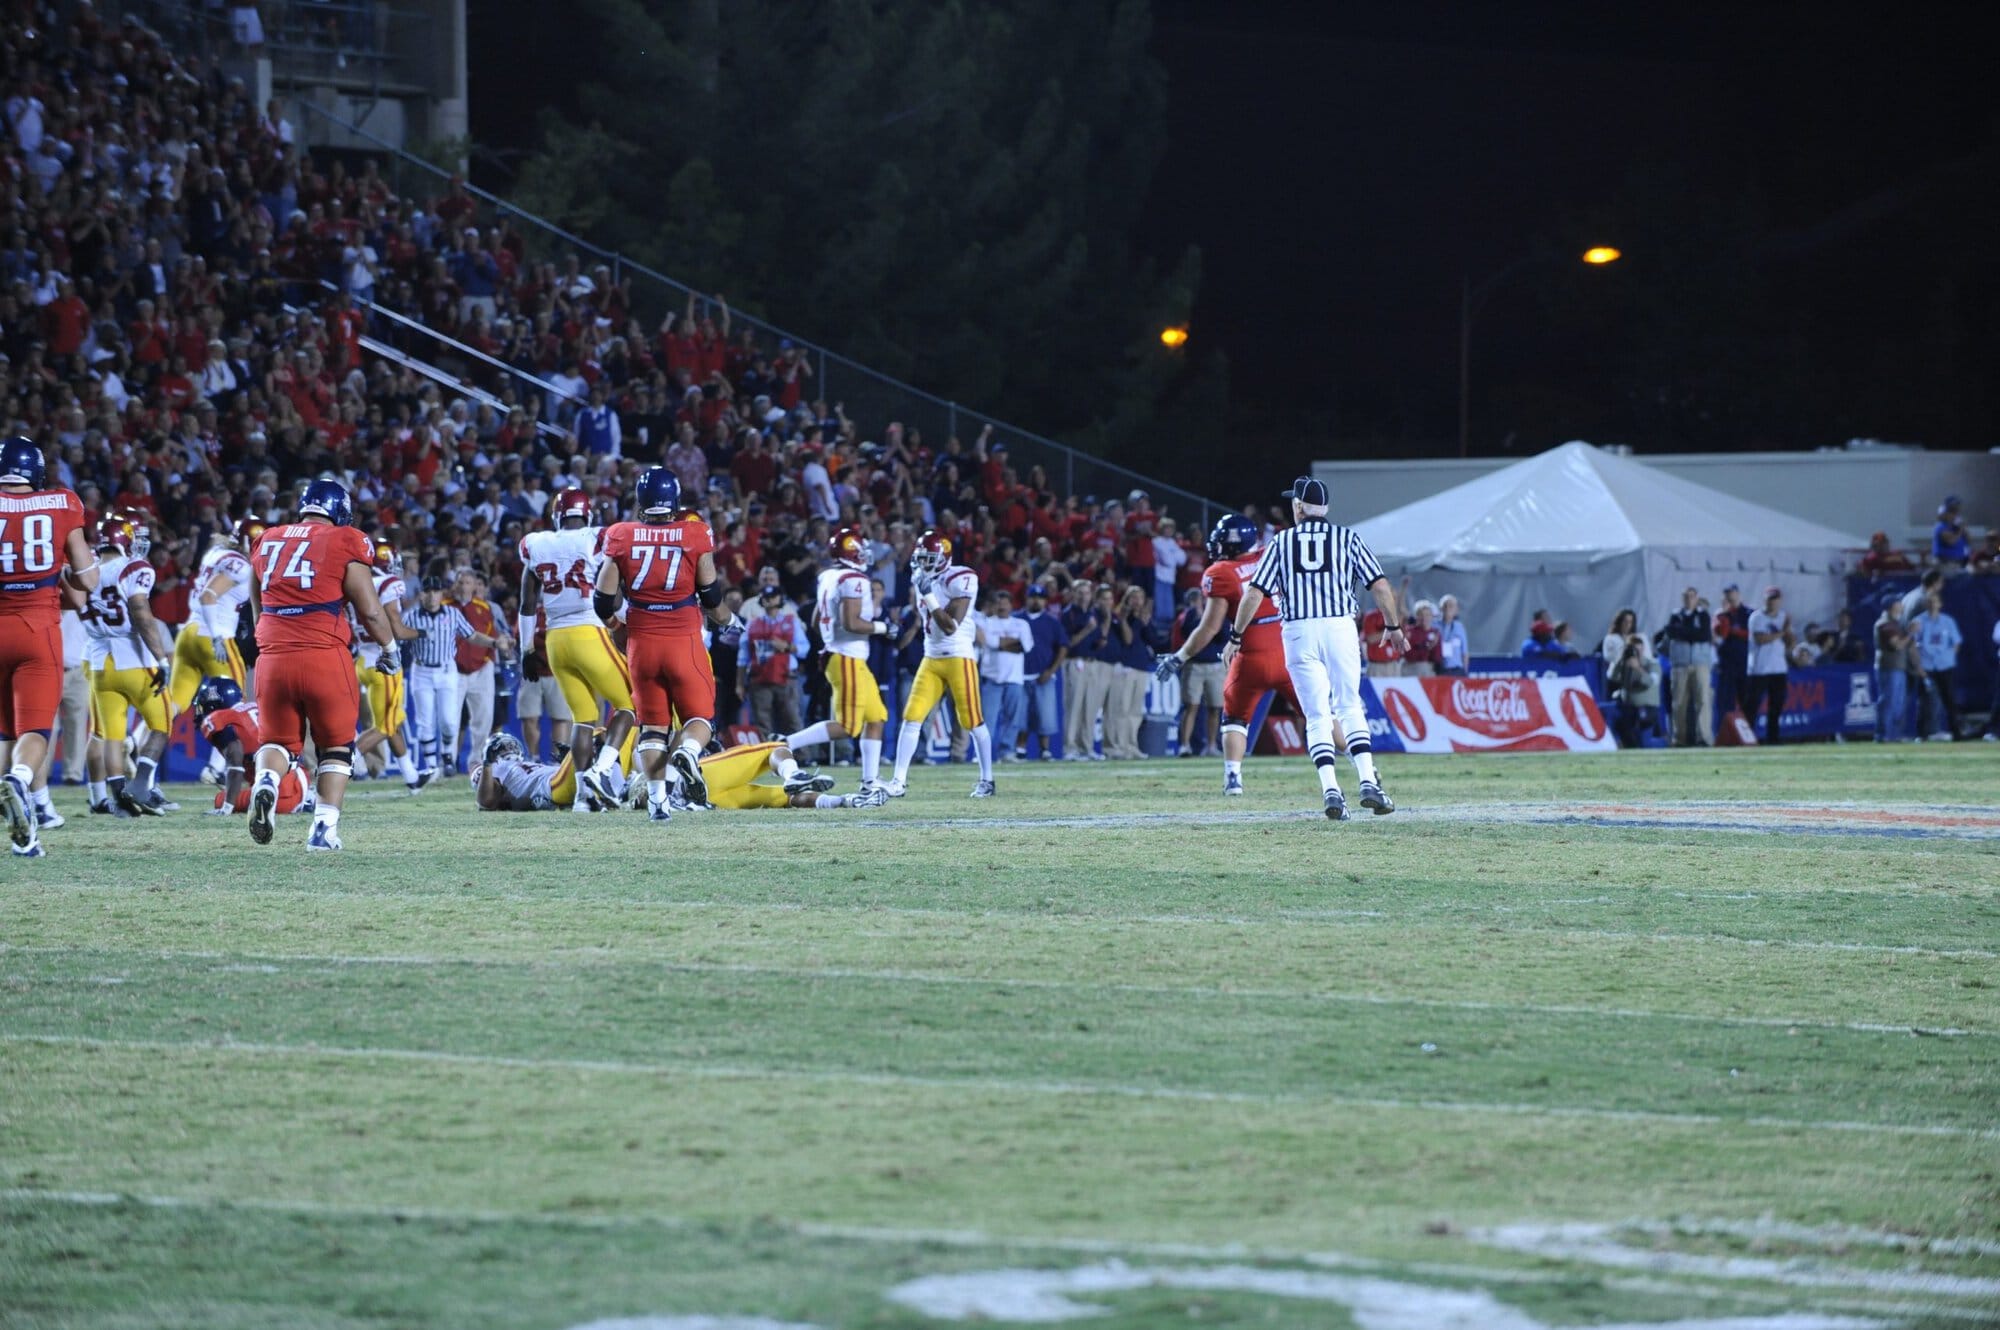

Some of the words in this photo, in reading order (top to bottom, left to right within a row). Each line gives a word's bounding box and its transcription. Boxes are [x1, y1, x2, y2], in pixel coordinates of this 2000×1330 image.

[283, 526, 312, 538] DIAZ
[634, 528, 682, 542] BRITTON
[261, 541, 315, 591] 74
[631, 545, 683, 591] 77
[1298, 533, 1327, 571] U
